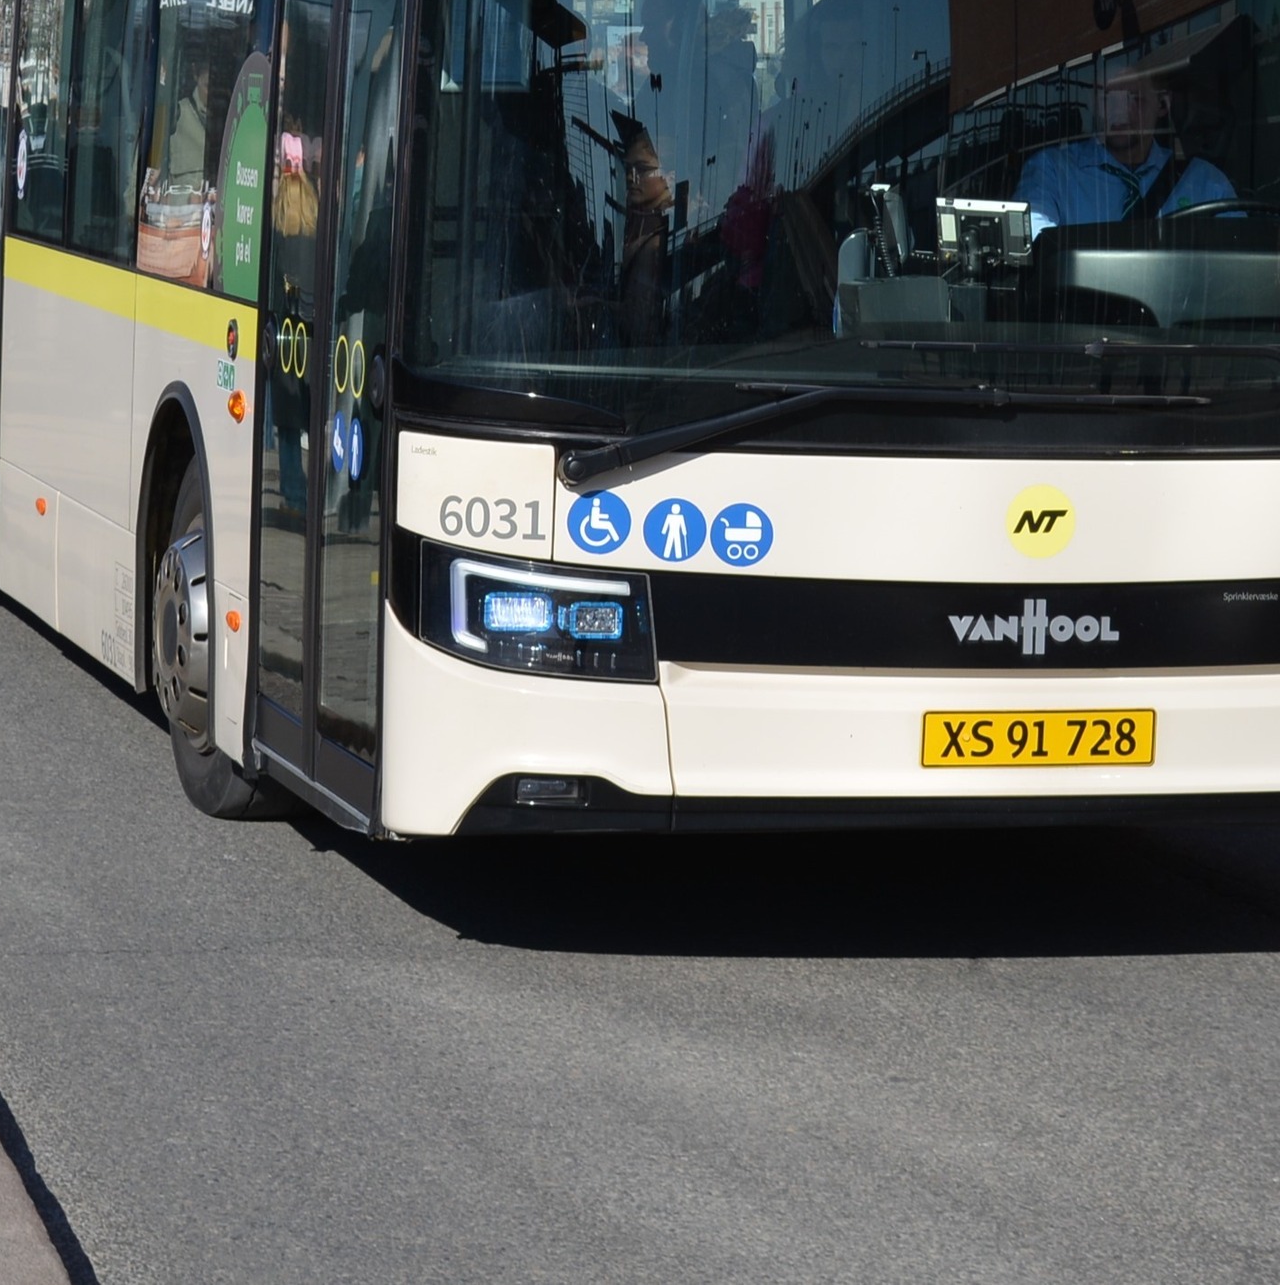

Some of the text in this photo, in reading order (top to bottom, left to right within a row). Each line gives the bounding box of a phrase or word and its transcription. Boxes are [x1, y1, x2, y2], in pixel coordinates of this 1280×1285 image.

[235, 161, 258, 188] Bussen
[410, 445, 437, 456] Ladestik
[439, 495, 546, 541] 6031
[1013, 509, 1069, 534] NT
[1222, 591, 1279, 602] Sprinklervæske
[940, 718, 1137, 759] XS 91 728
